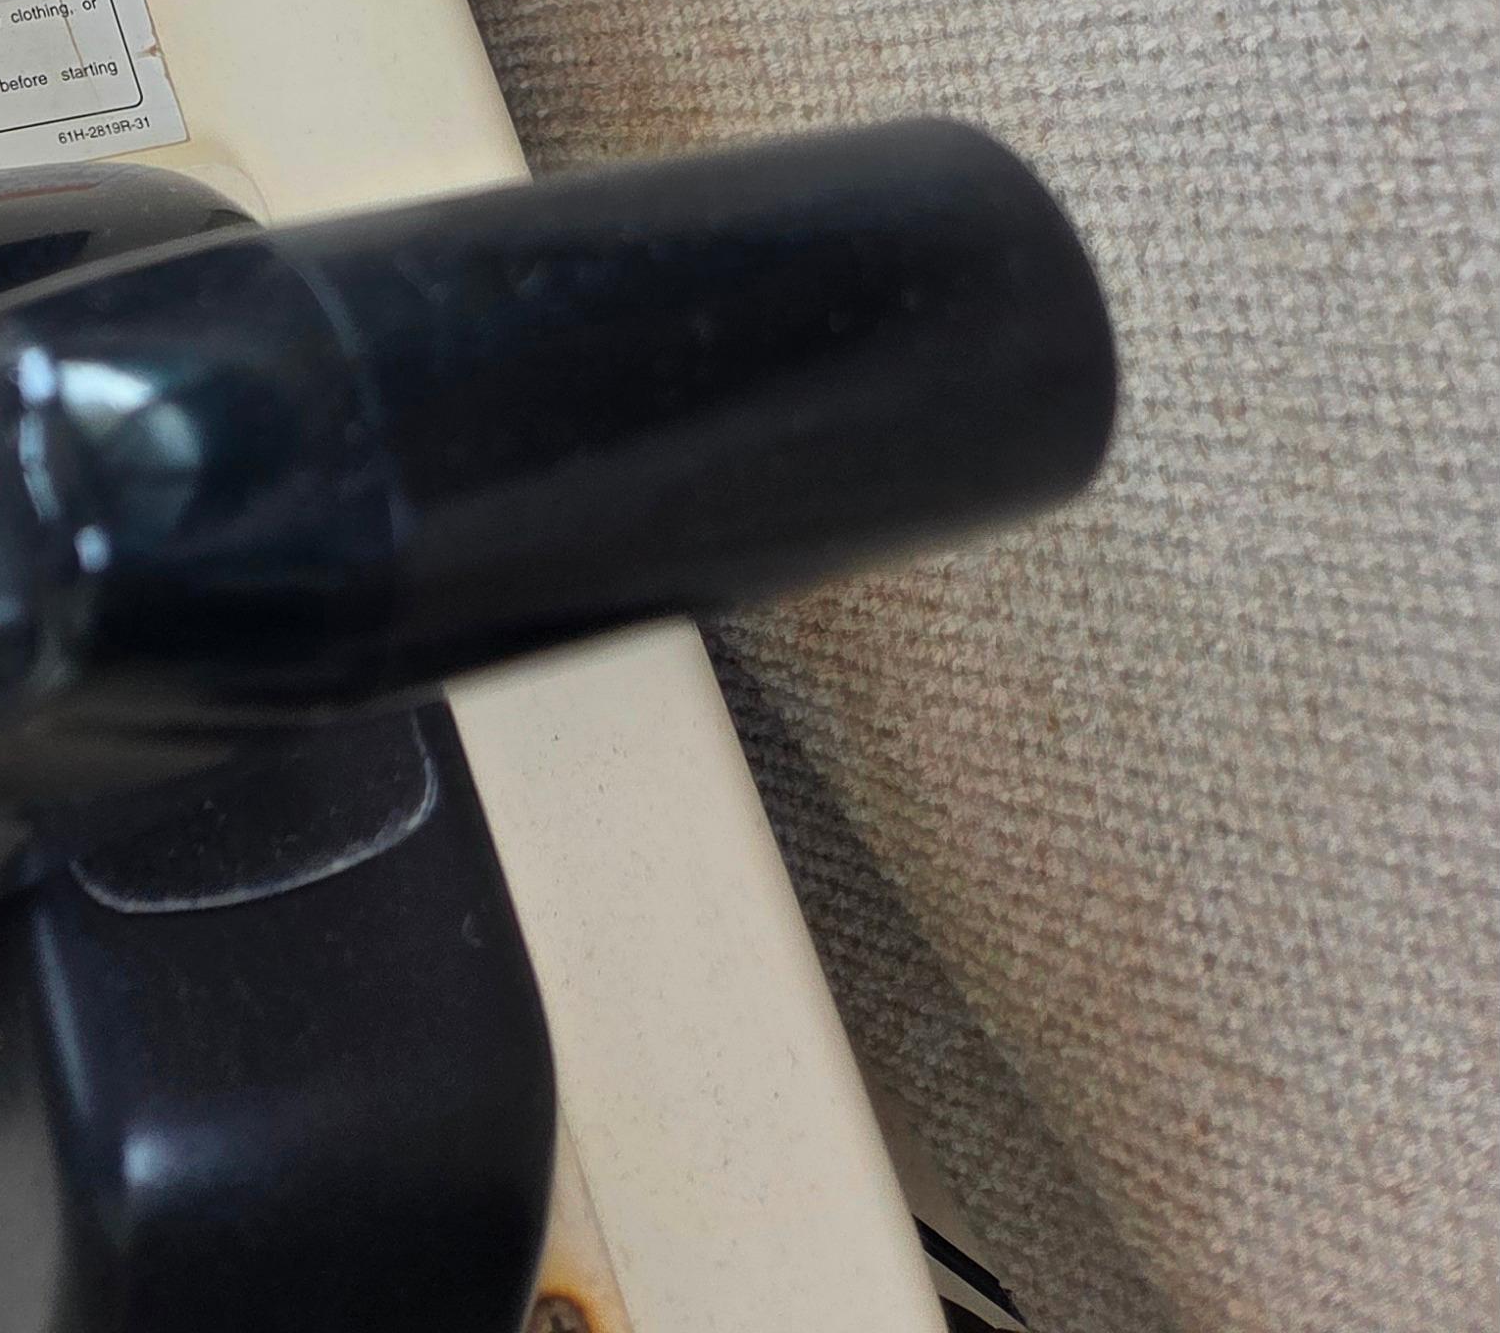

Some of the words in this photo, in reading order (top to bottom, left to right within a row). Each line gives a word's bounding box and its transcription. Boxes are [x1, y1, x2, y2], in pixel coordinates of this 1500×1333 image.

[10, 0, 74, 24] clothing,
[60, 61, 119, 82] starting
[58, 116, 151, 145] 61H-2819R-31
